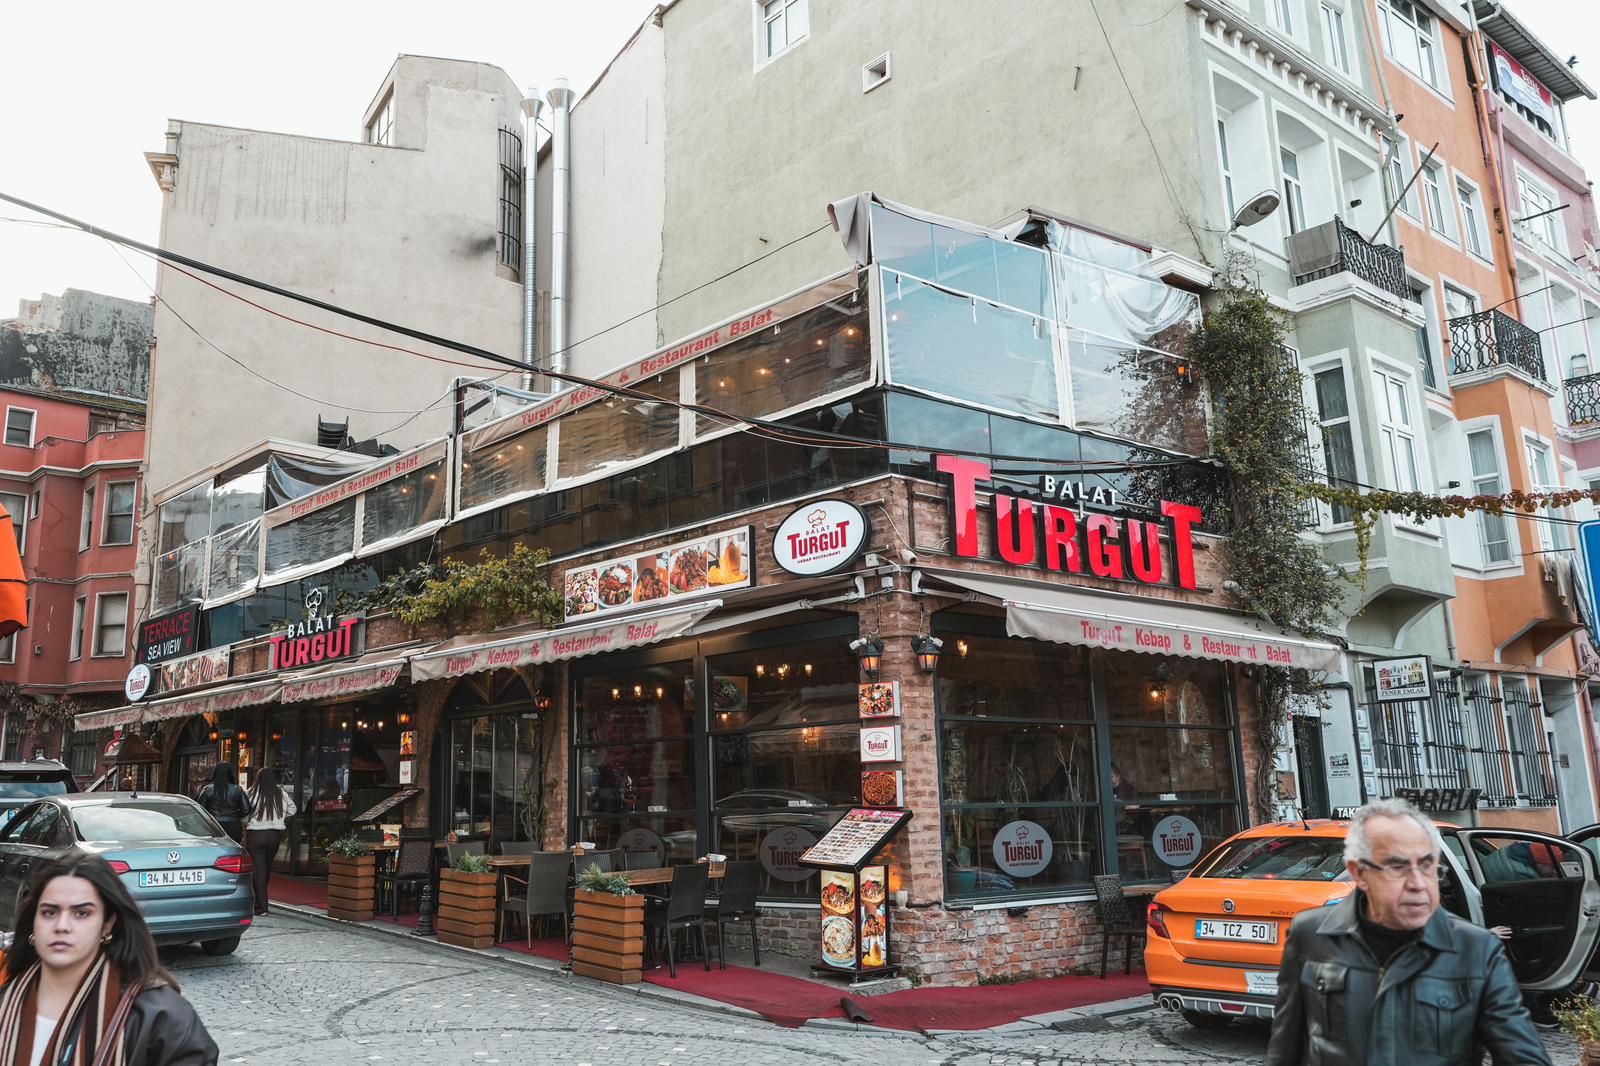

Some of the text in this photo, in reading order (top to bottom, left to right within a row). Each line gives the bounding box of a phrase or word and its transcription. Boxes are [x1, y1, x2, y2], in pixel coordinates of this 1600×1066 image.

[639, 331, 721, 376] Restaurant
[729, 308, 773, 336] Balat
[316, 489, 339, 505] Kebap
[348, 466, 392, 493] Restaurant
[395, 455, 419, 474] Balat
[1044, 474, 1118, 505] BALAT
[805, 525, 830, 536] BALAT
[936, 455, 1203, 591] TURGUT
[787, 520, 849, 560] TURGUT
[145, 611, 191, 645] TERRACE
[287, 614, 334, 638] BALAT
[147, 637, 182, 661] SEA VIEW
[269, 617, 360, 670] TURGUT
[487, 648, 521, 667] Kebap
[532, 643, 539, 657] &
[552, 629, 614, 656] Restaurant
[627, 621, 659, 641] Balat
[1135, 627, 1171, 651] Kebap
[1183, 634, 1192, 650] &
[1202, 637, 1258, 659] Restaurnt
[1266, 646, 1291, 663] Balat
[1337, 807, 1359, 818] TAK
[1002, 840, 1044, 862] TURGUT
[1160, 832, 1195, 853] TURGUT
[147, 871, 203, 885] 34 NJ 4416
[1202, 922, 1266, 939] 34 TCZ 50
